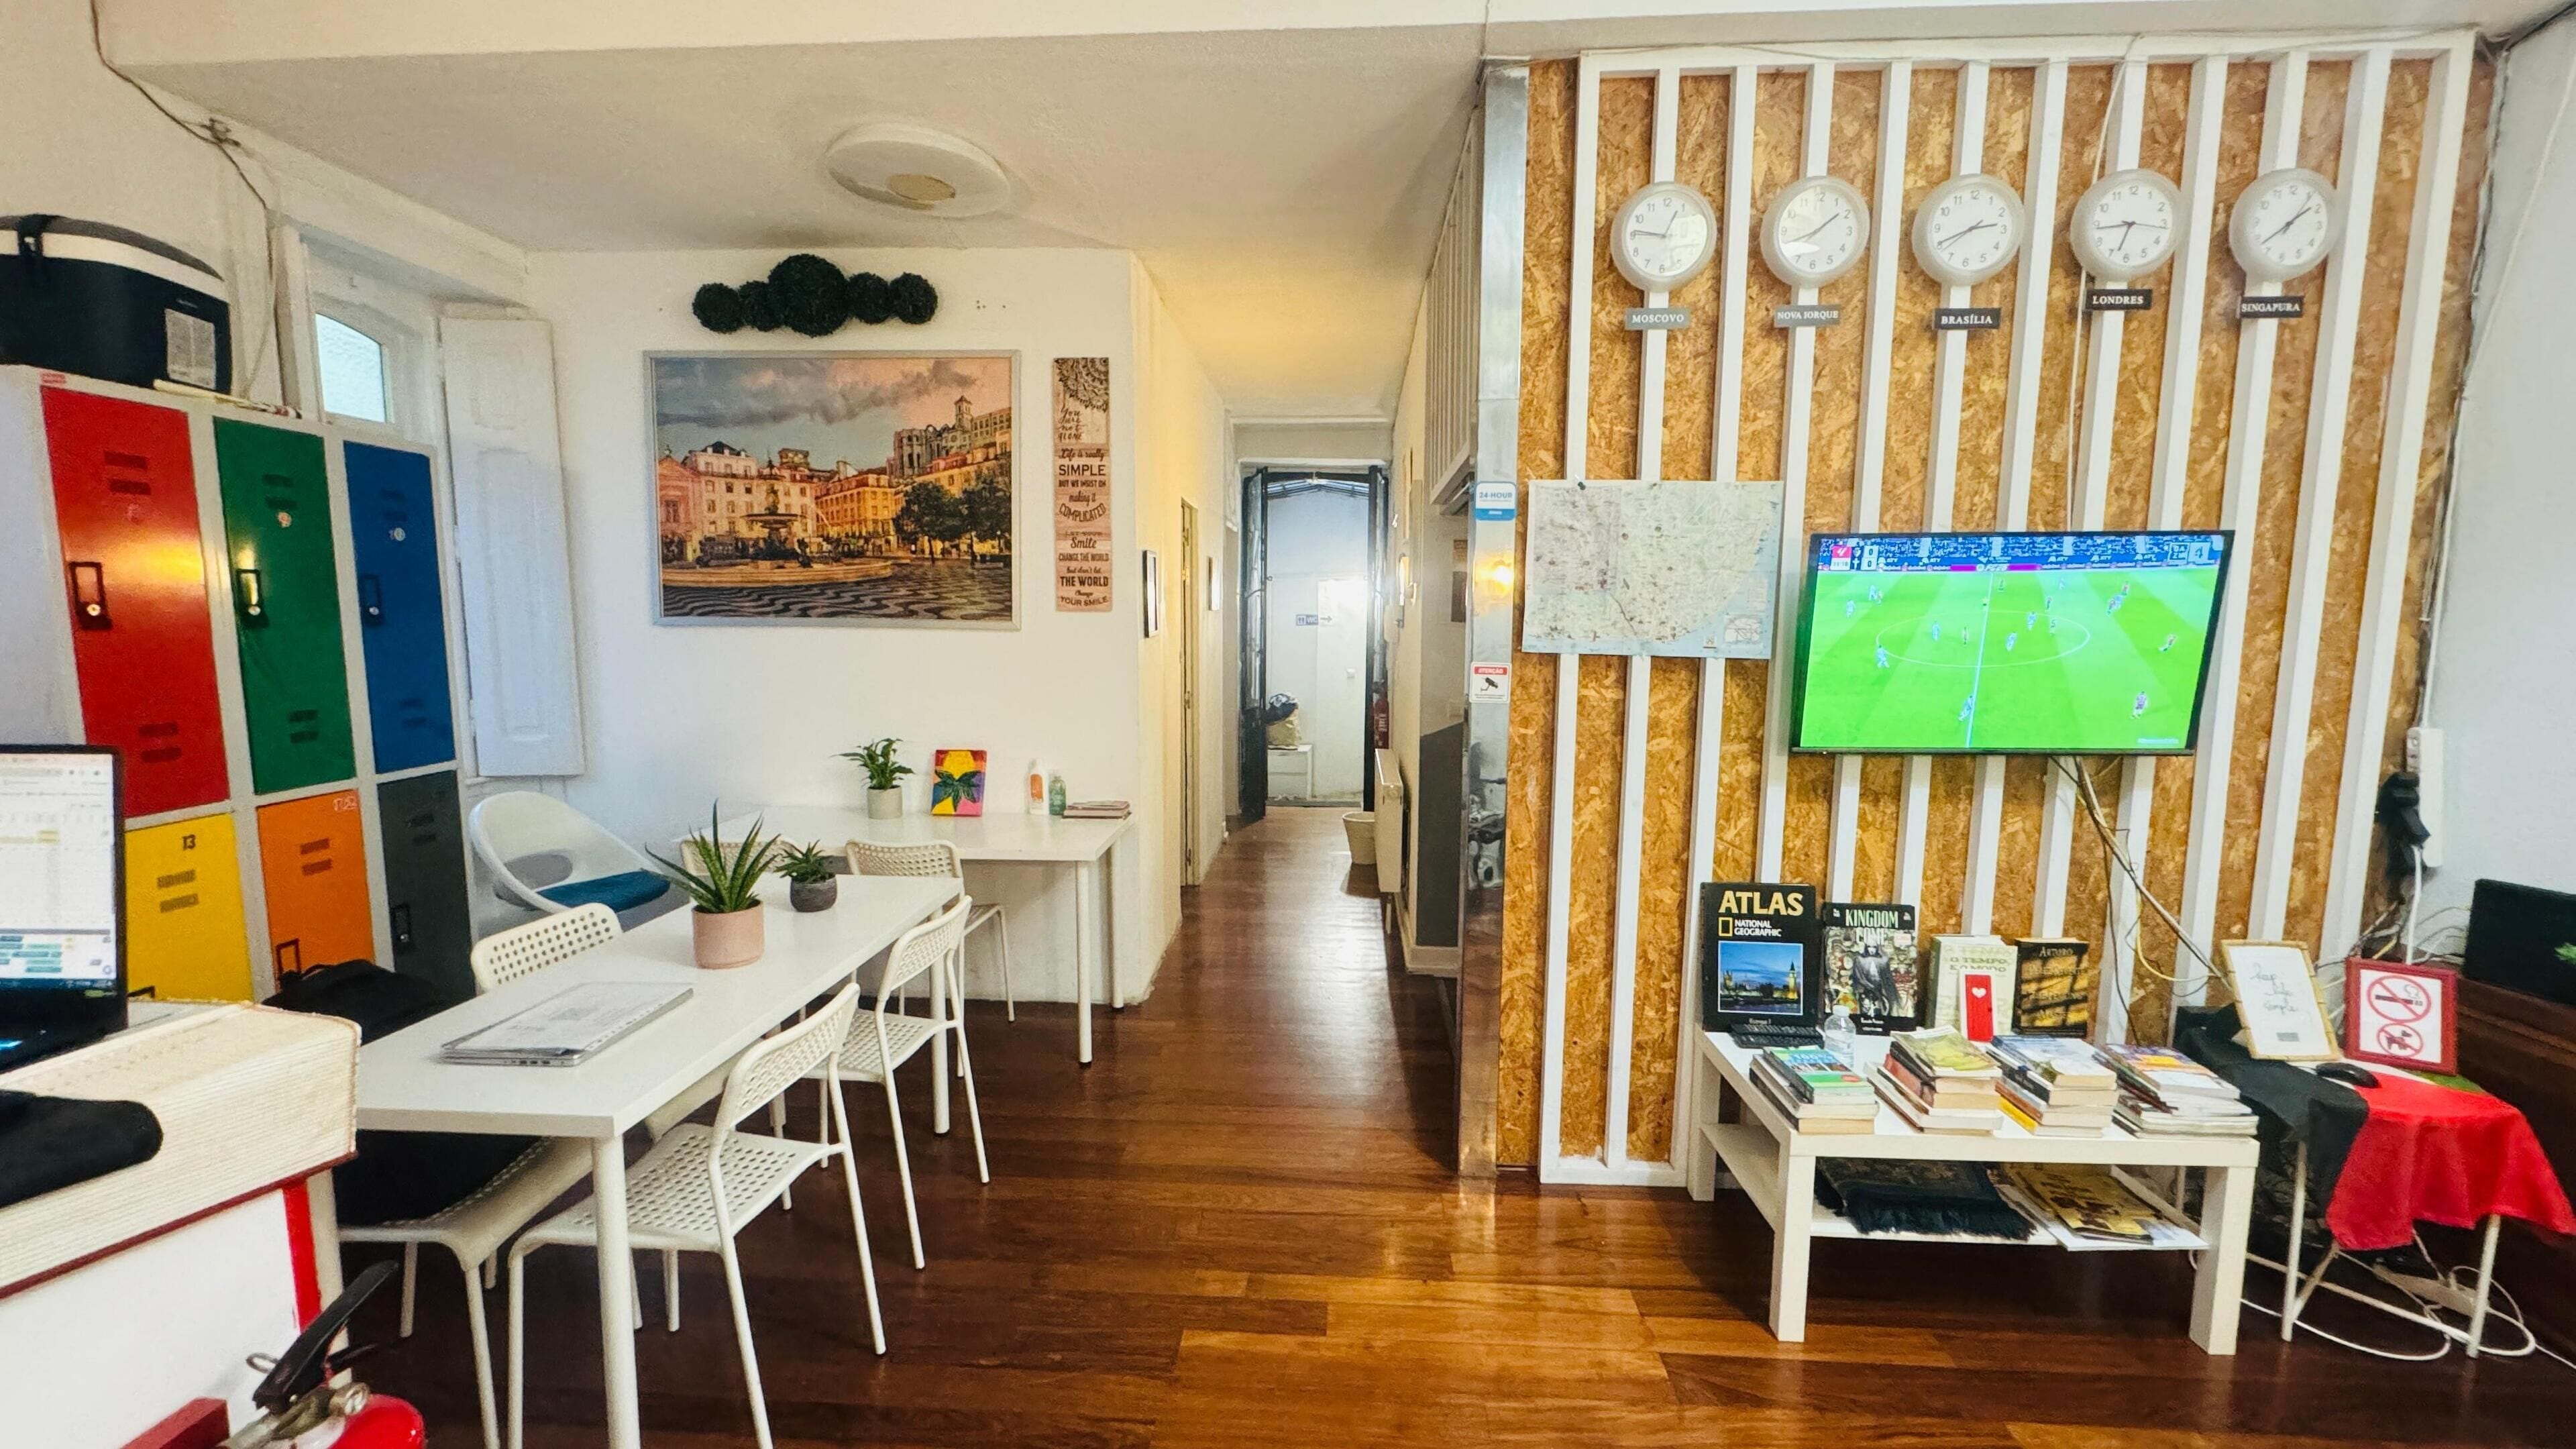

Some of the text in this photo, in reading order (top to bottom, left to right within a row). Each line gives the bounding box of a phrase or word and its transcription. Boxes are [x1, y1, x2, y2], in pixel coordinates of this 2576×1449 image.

[1971, 190, 1980, 199] 12
[2129, 186, 2139, 195] 12
[1954, 196, 1962, 205] 11
[2113, 192, 2121, 200] 11
[1663, 198, 1672, 207] 12
[1648, 203, 1655, 212] 11
[1941, 207, 1949, 217] 10
[2099, 203, 2108, 213] 10
[1635, 214, 1644, 224] 10
[2092, 296, 2143, 305] LONDRES
[2241, 303, 2300, 312] SINGAPURA
[1632, 314, 1684, 323] MOSCOVO
[1778, 311, 1802, 319] NOVA
[1941, 313, 1992, 325] BRASÍLIA
[1059, 464, 1106, 476] SIMPLE
[1059, 502, 1106, 522] COMPLICATED
[1071, 537, 1096, 549] Smile
[1080, 553, 1089, 561] THE
[1060, 576, 1109, 586] THE WORLD
[1061, 596, 1109, 606] YOUR SMILE
[182, 835, 197, 851] 13
[1718, 890, 1804, 916] ATLAS
[1845, 908, 1898, 928] KINGDOM
[1734, 919, 1772, 928] NATIONAL
[1734, 928, 1782, 937] GEOGRAPHIC
